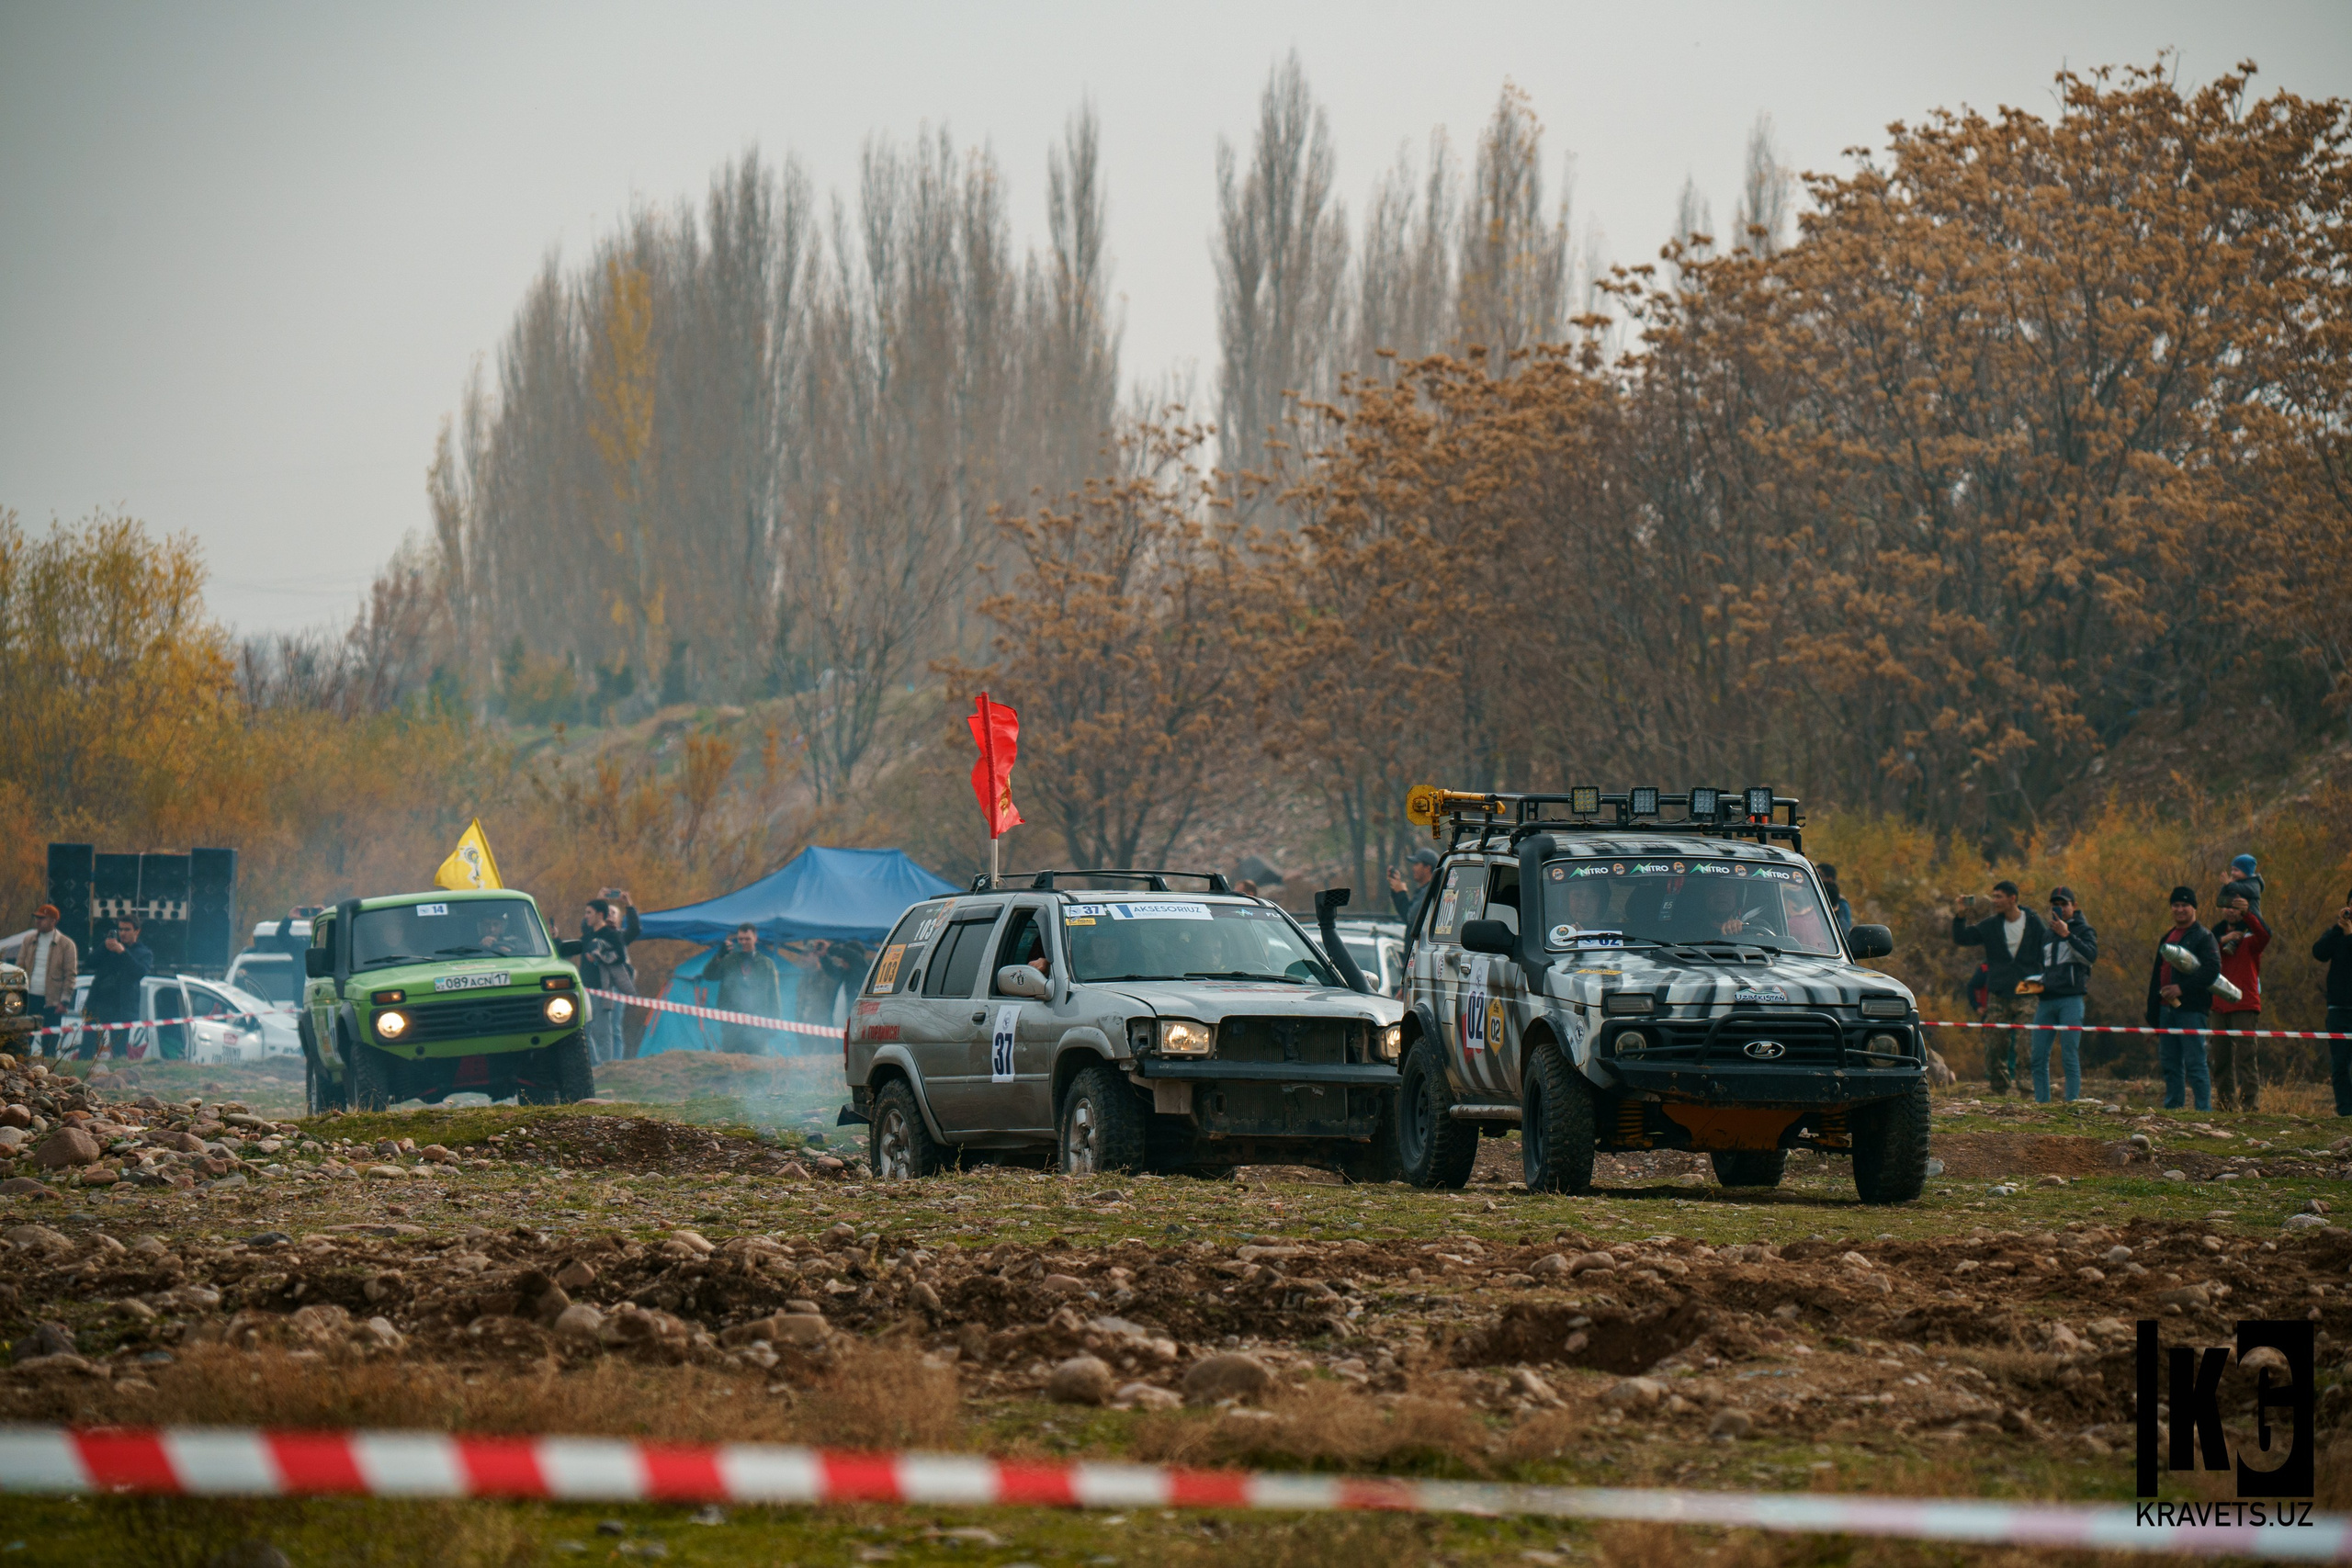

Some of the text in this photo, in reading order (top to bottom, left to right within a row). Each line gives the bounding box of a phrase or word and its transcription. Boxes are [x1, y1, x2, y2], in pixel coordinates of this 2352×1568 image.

[1579, 864, 1791, 880] NITRO NITRO NITRO NITRO
[432, 905, 444, 914] 14
[1082, 906, 1100, 915] 37
[1133, 906, 1202, 914] AKSESORIUZ
[913, 918, 937, 942] 103
[446, 976, 469, 988] 089
[469, 976, 492, 987] ACN
[494, 973, 508, 985] 17
[879, 961, 898, 983] 103
[1467, 990, 1485, 1040] 02
[1490, 1018, 1501, 1043] 02
[994, 1032, 1013, 1076] 37
